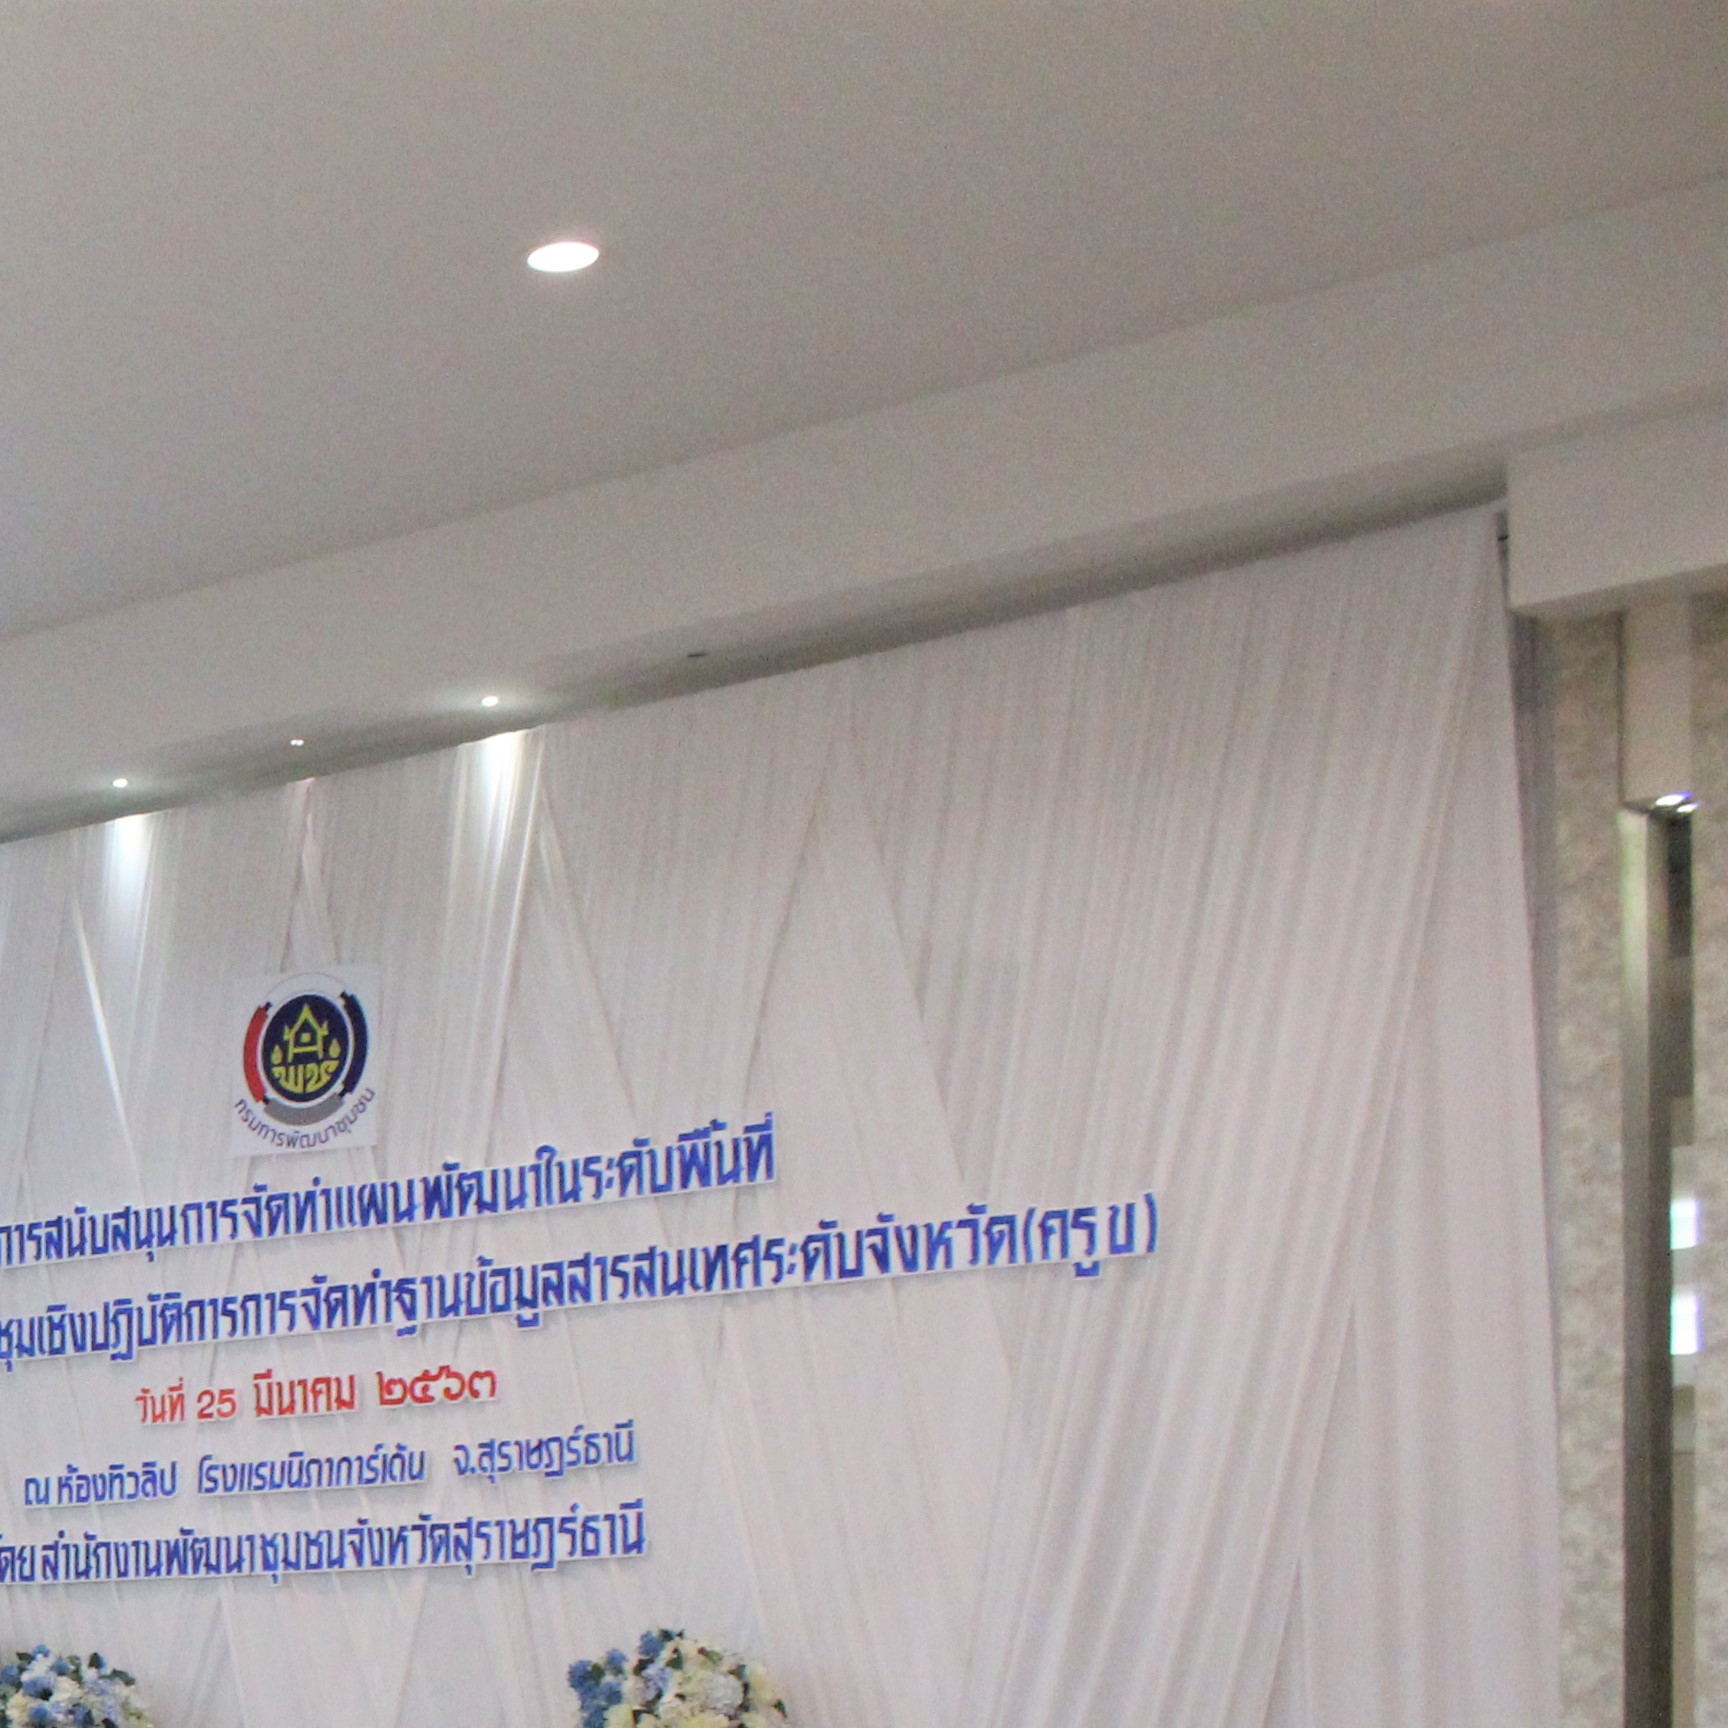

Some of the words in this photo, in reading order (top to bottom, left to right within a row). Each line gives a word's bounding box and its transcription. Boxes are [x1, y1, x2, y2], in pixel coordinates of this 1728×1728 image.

[135, 1378, 185, 1424] วันที่
[196, 1388, 237, 1420] 25
[253, 1368, 356, 1418] มีนาคม
[376, 1365, 498, 1406] ๒๕๖๓
